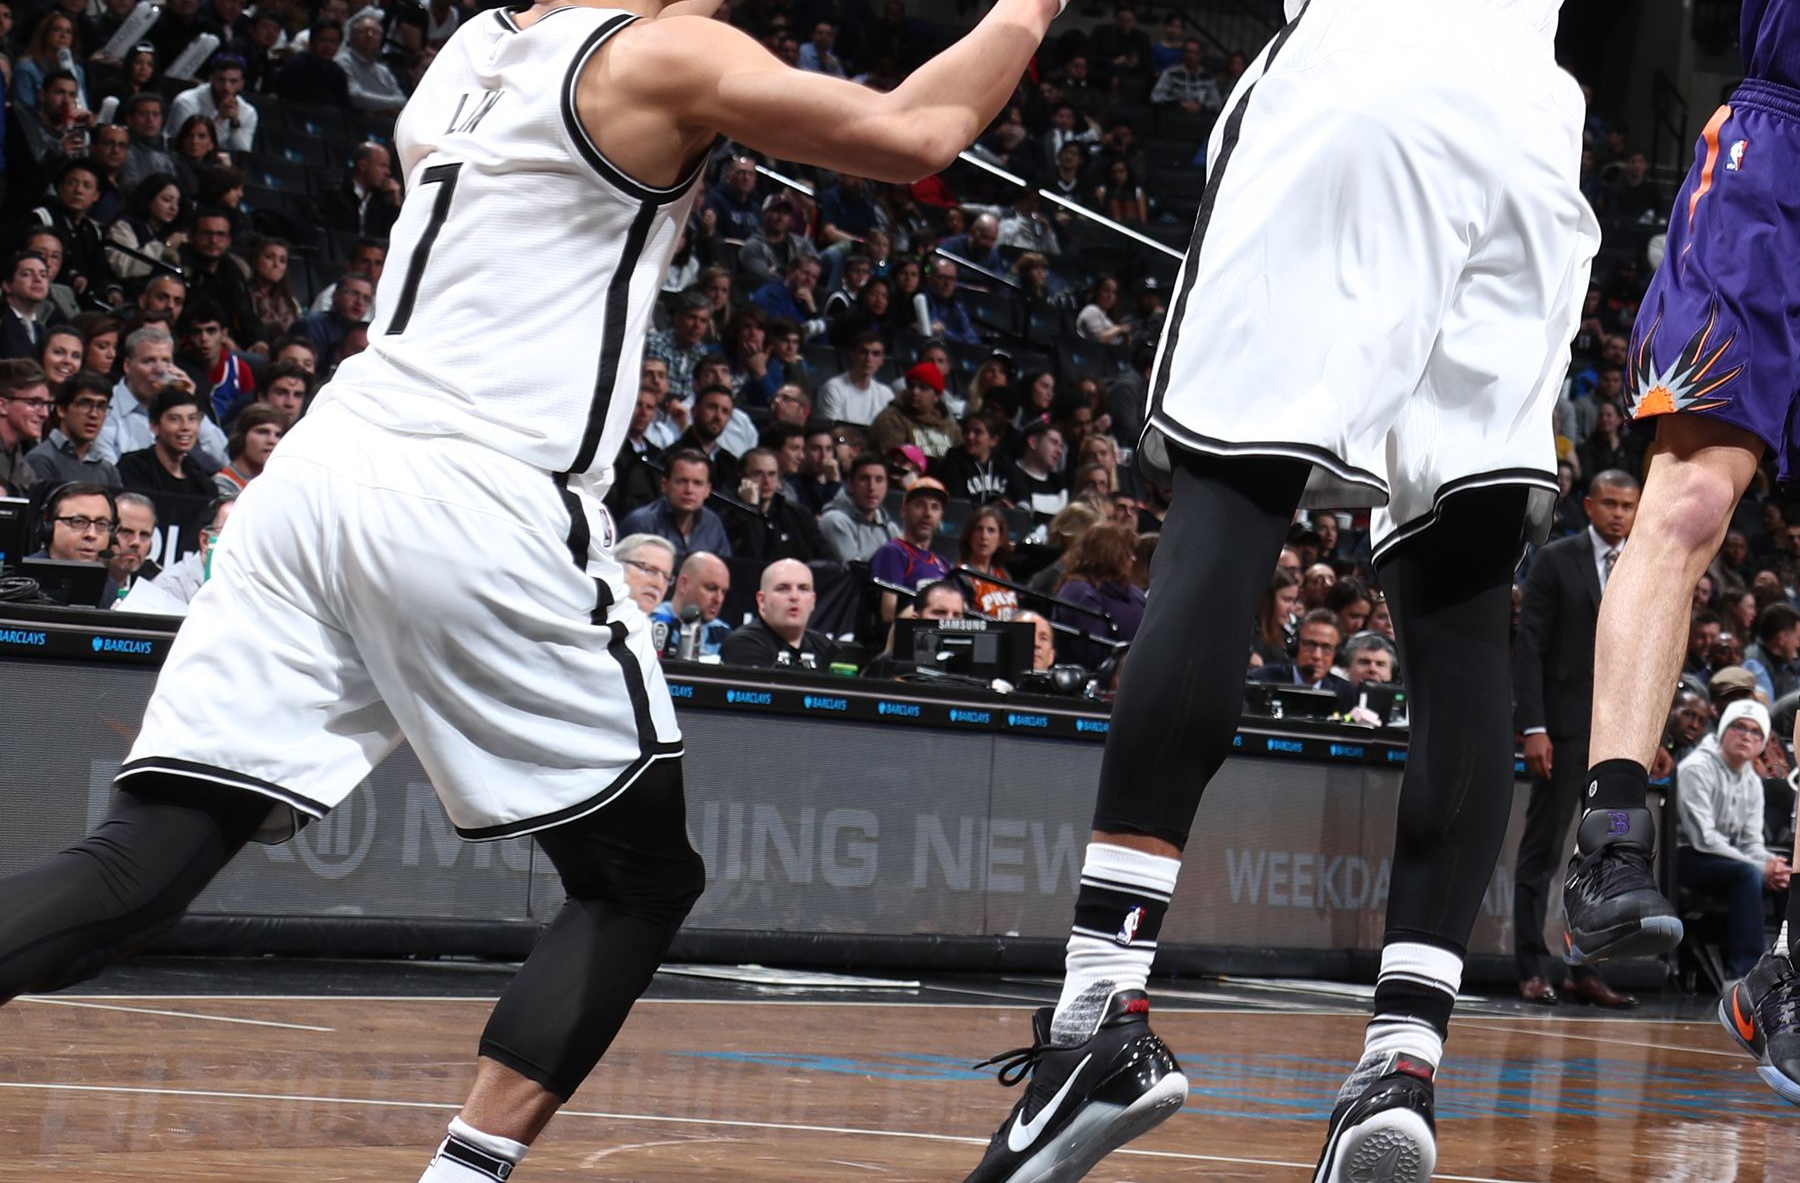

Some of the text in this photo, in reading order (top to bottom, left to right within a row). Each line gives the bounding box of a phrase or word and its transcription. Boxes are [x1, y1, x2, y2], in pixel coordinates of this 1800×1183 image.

[444, 89, 506, 135] LIN
[384, 161, 465, 336] 7
[938, 619, 987, 631] SAMSUNG
[103, 638, 152, 654] BARCLAYS
[735, 691, 772, 705] BARCLAYS
[812, 697, 848, 711] BARCLAYS
[886, 703, 920, 717] BARCLAYS
[957, 710, 990, 724] BARCLAYS
[1015, 714, 1048, 728] BARCLAYS
